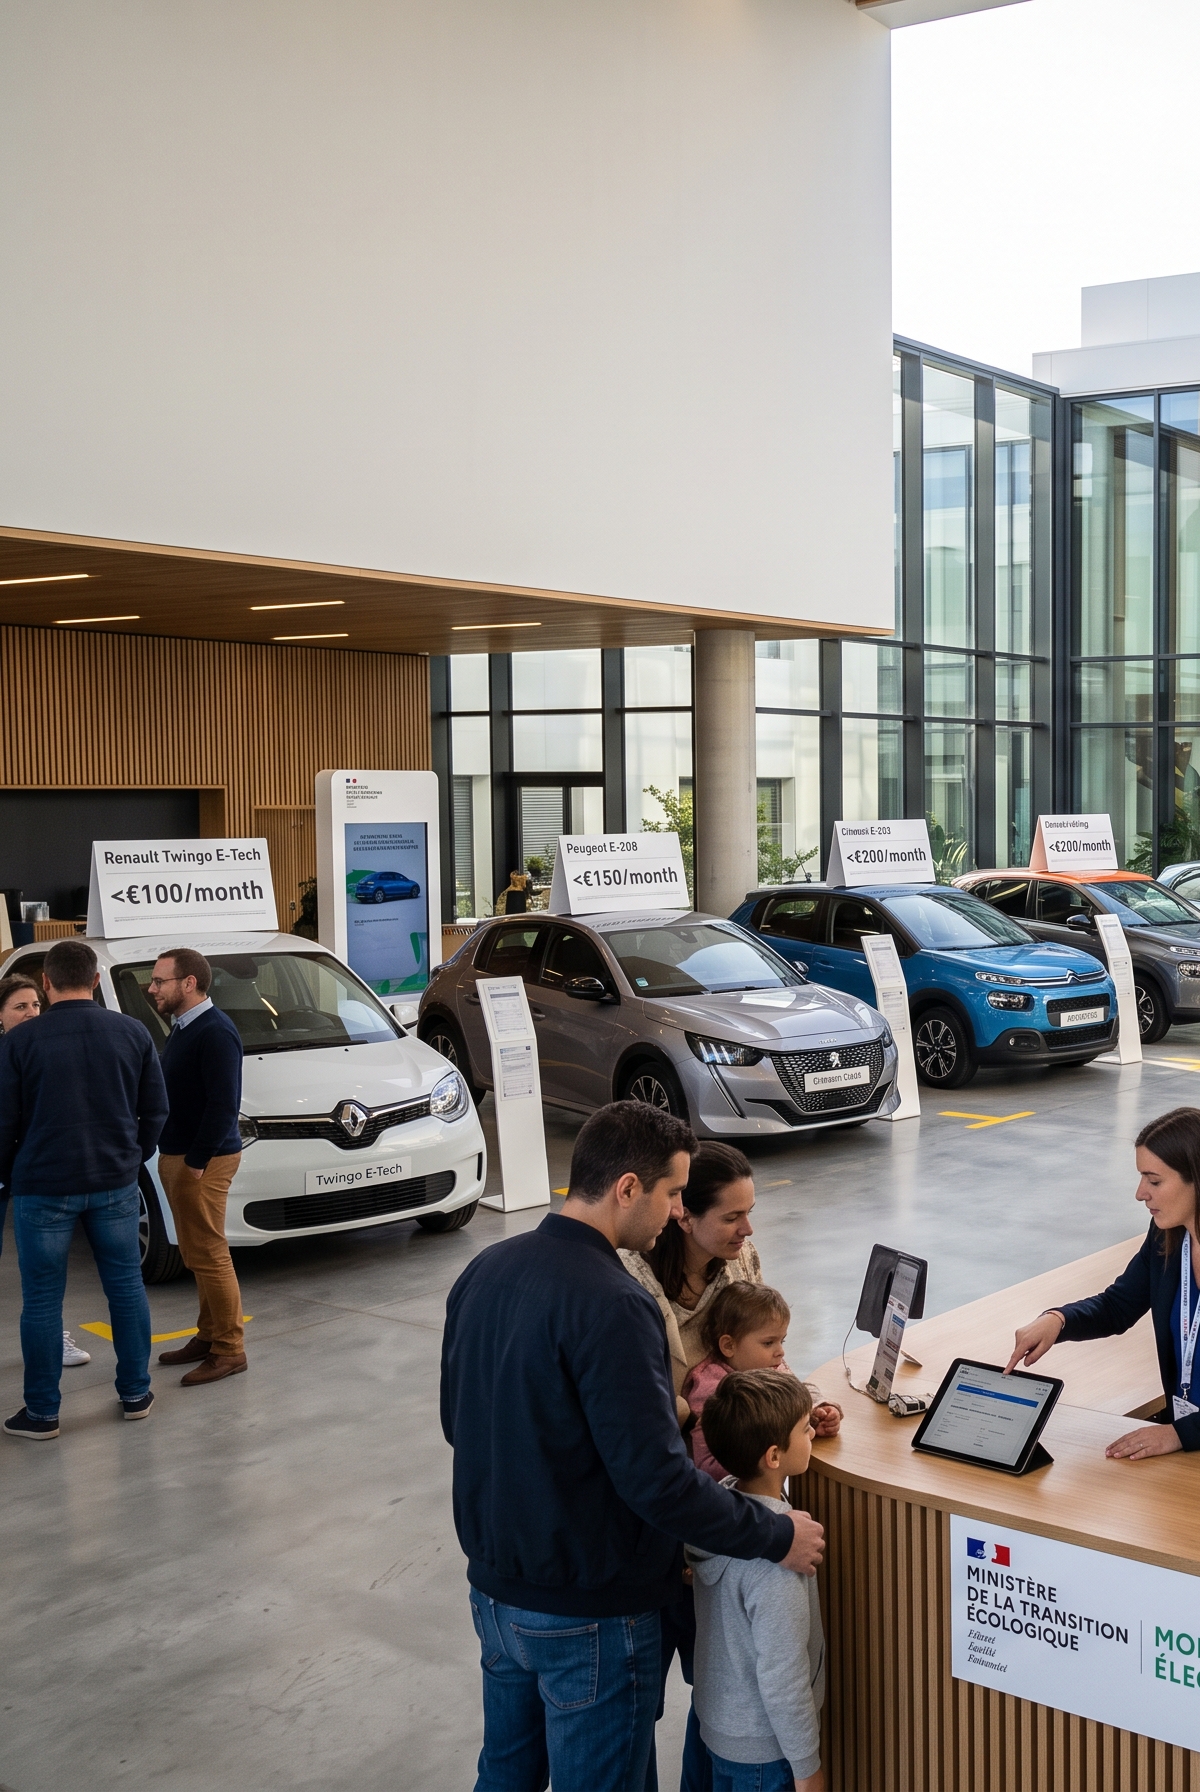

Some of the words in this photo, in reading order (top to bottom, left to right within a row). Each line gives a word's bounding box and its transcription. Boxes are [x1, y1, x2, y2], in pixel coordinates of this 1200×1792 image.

[566, 843, 608, 856] Peugeot
[610, 841, 638, 853] E-208
[846, 847, 927, 863] <€200/month
[1049, 839, 1111, 852] <€200/month
[104, 850, 159, 865] Renault
[162, 849, 212, 865] Twingo
[216, 848, 261, 862] E-Tech
[573, 867, 678, 887] <€150/month
[111, 880, 264, 905] <€100/month
[316, 1172, 363, 1186] Twingo
[365, 1163, 402, 1178] E-Tech
[967, 1565, 1057, 1603] MINISTÈRE
[967, 1586, 988, 1605] DE
[994, 1593, 1015, 1613] LA
[1020, 1600, 1129, 1645] TRANSITION
[967, 1603, 1079, 1652] ÉCOLOGIQUE
